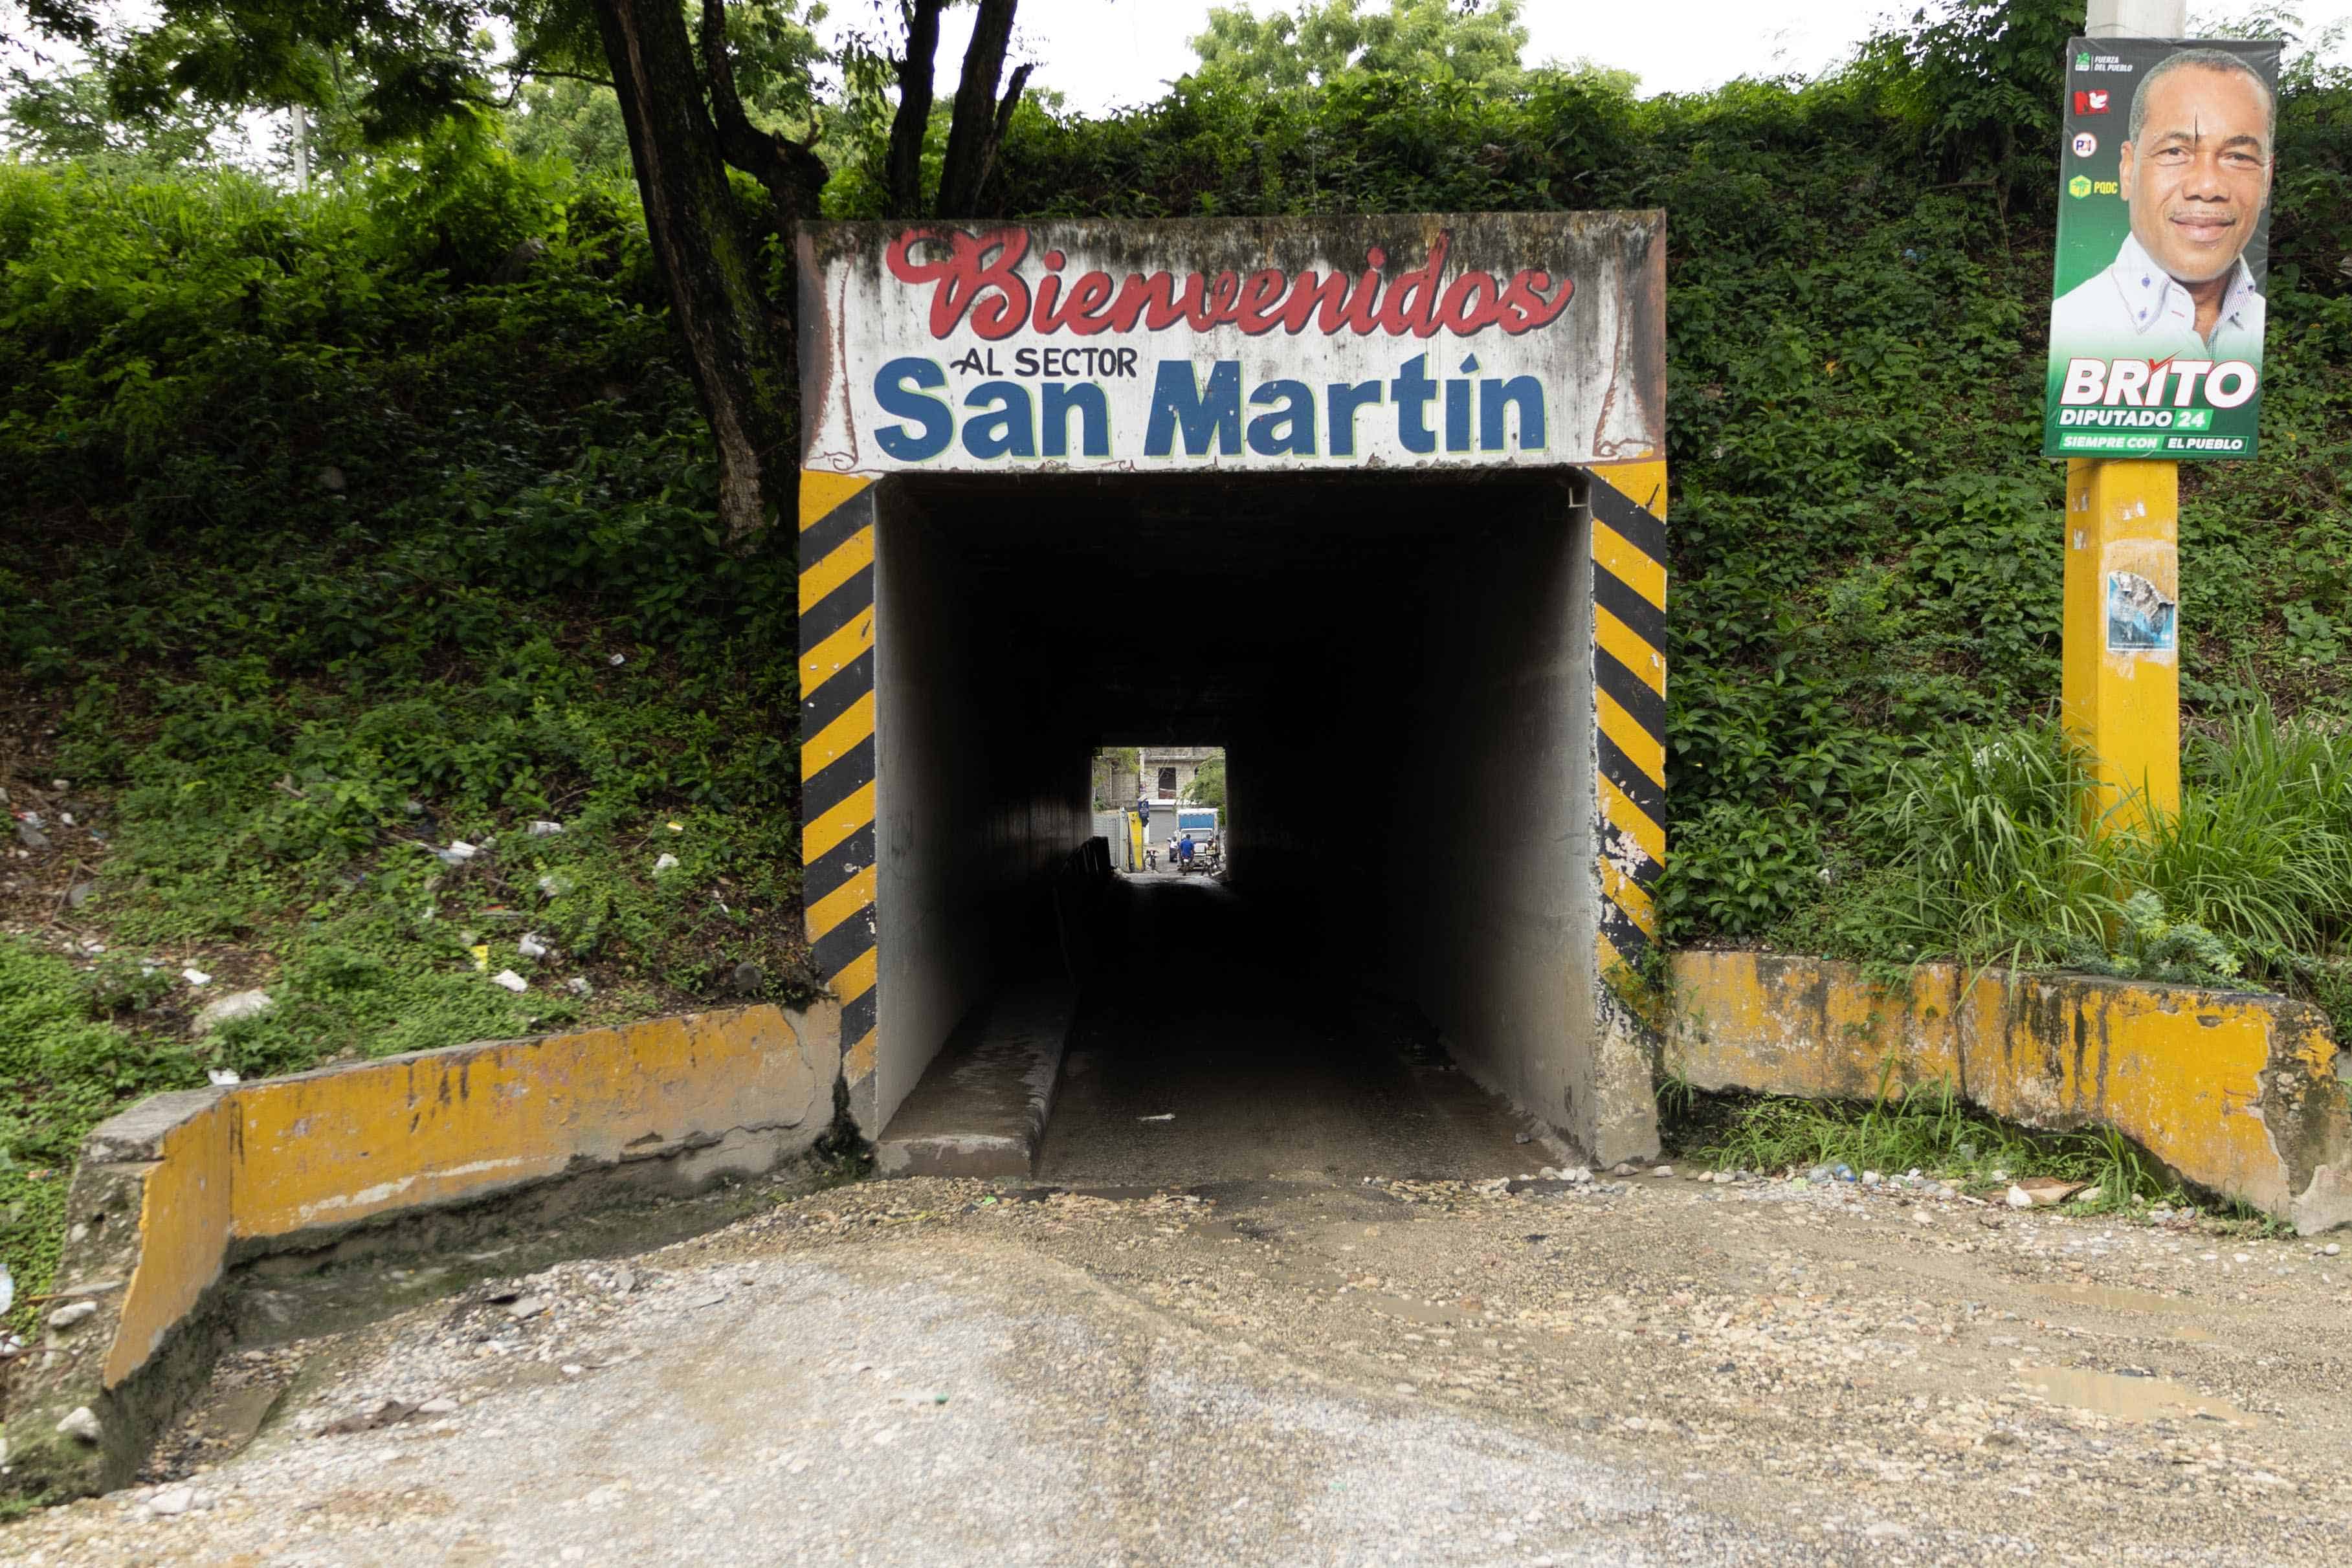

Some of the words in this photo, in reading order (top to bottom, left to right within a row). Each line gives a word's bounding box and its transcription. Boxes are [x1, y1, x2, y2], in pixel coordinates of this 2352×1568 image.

[886, 228, 1575, 340] Bienvenidos
[950, 348, 1003, 376] AL
[1014, 348, 1138, 377] SECTOR
[2059, 356, 2258, 408] BRITO
[874, 357, 1114, 462] San
[1144, 352, 1549, 459] Martín
[2059, 409, 2173, 427] DIPUTADO
[2177, 412, 2206, 428] 24
[2063, 436, 2124, 448] SIEMPRE
[2126, 437, 2158, 448] CON
[2167, 437, 2185, 448] EL
[2186, 438, 2243, 450] PUEBLO
